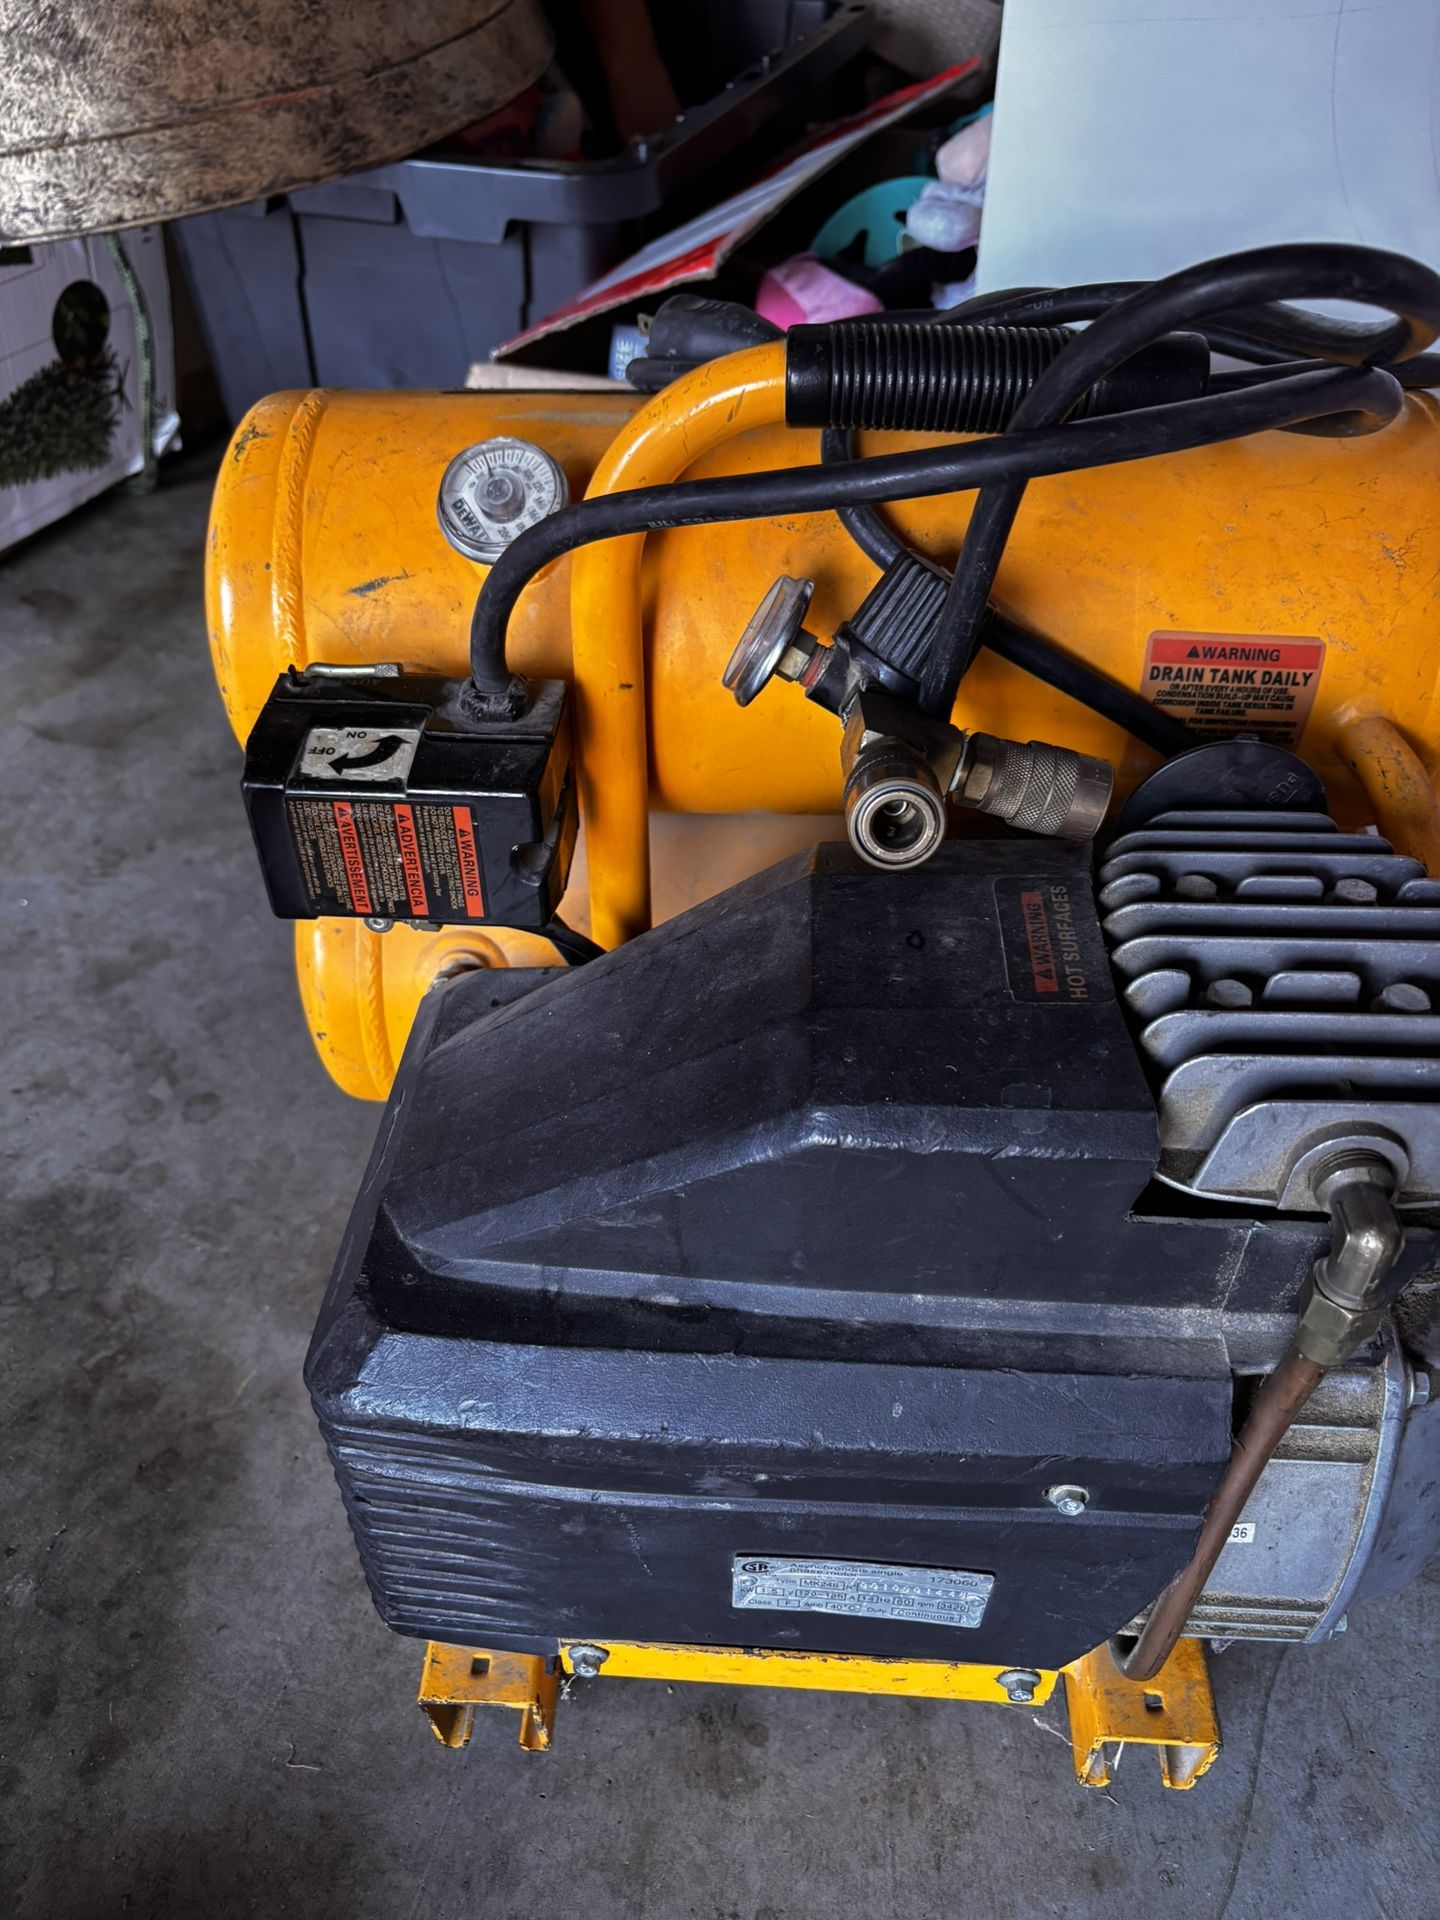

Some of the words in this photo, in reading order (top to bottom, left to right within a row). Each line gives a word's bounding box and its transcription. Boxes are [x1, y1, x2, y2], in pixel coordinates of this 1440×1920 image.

[1200, 645, 1282, 661] WARNING
[1149, 665, 1205, 682] DRAIN
[1208, 668, 1257, 685] TANK
[1260, 670, 1312, 687] DAILY
[1181, 683, 1204, 691] AFTER
[1204, 684, 1228, 692] EVERY
[346, 730, 368, 740] ON
[308, 746, 336, 757] OFF
[339, 820, 368, 908] AVERTISSEMENT
[399, 825, 424, 906] ADVERTENCIA
[459, 840, 479, 896] WARNING
[1050, 886, 1081, 961] SURFACES
[1027, 903, 1052, 966] WARNING
[1066, 966, 1088, 999] HOT
[929, 1576, 978, 1587] 173060
[897, 1609, 955, 1621] Continuous
[941, 1602, 966, 1611] 3420
